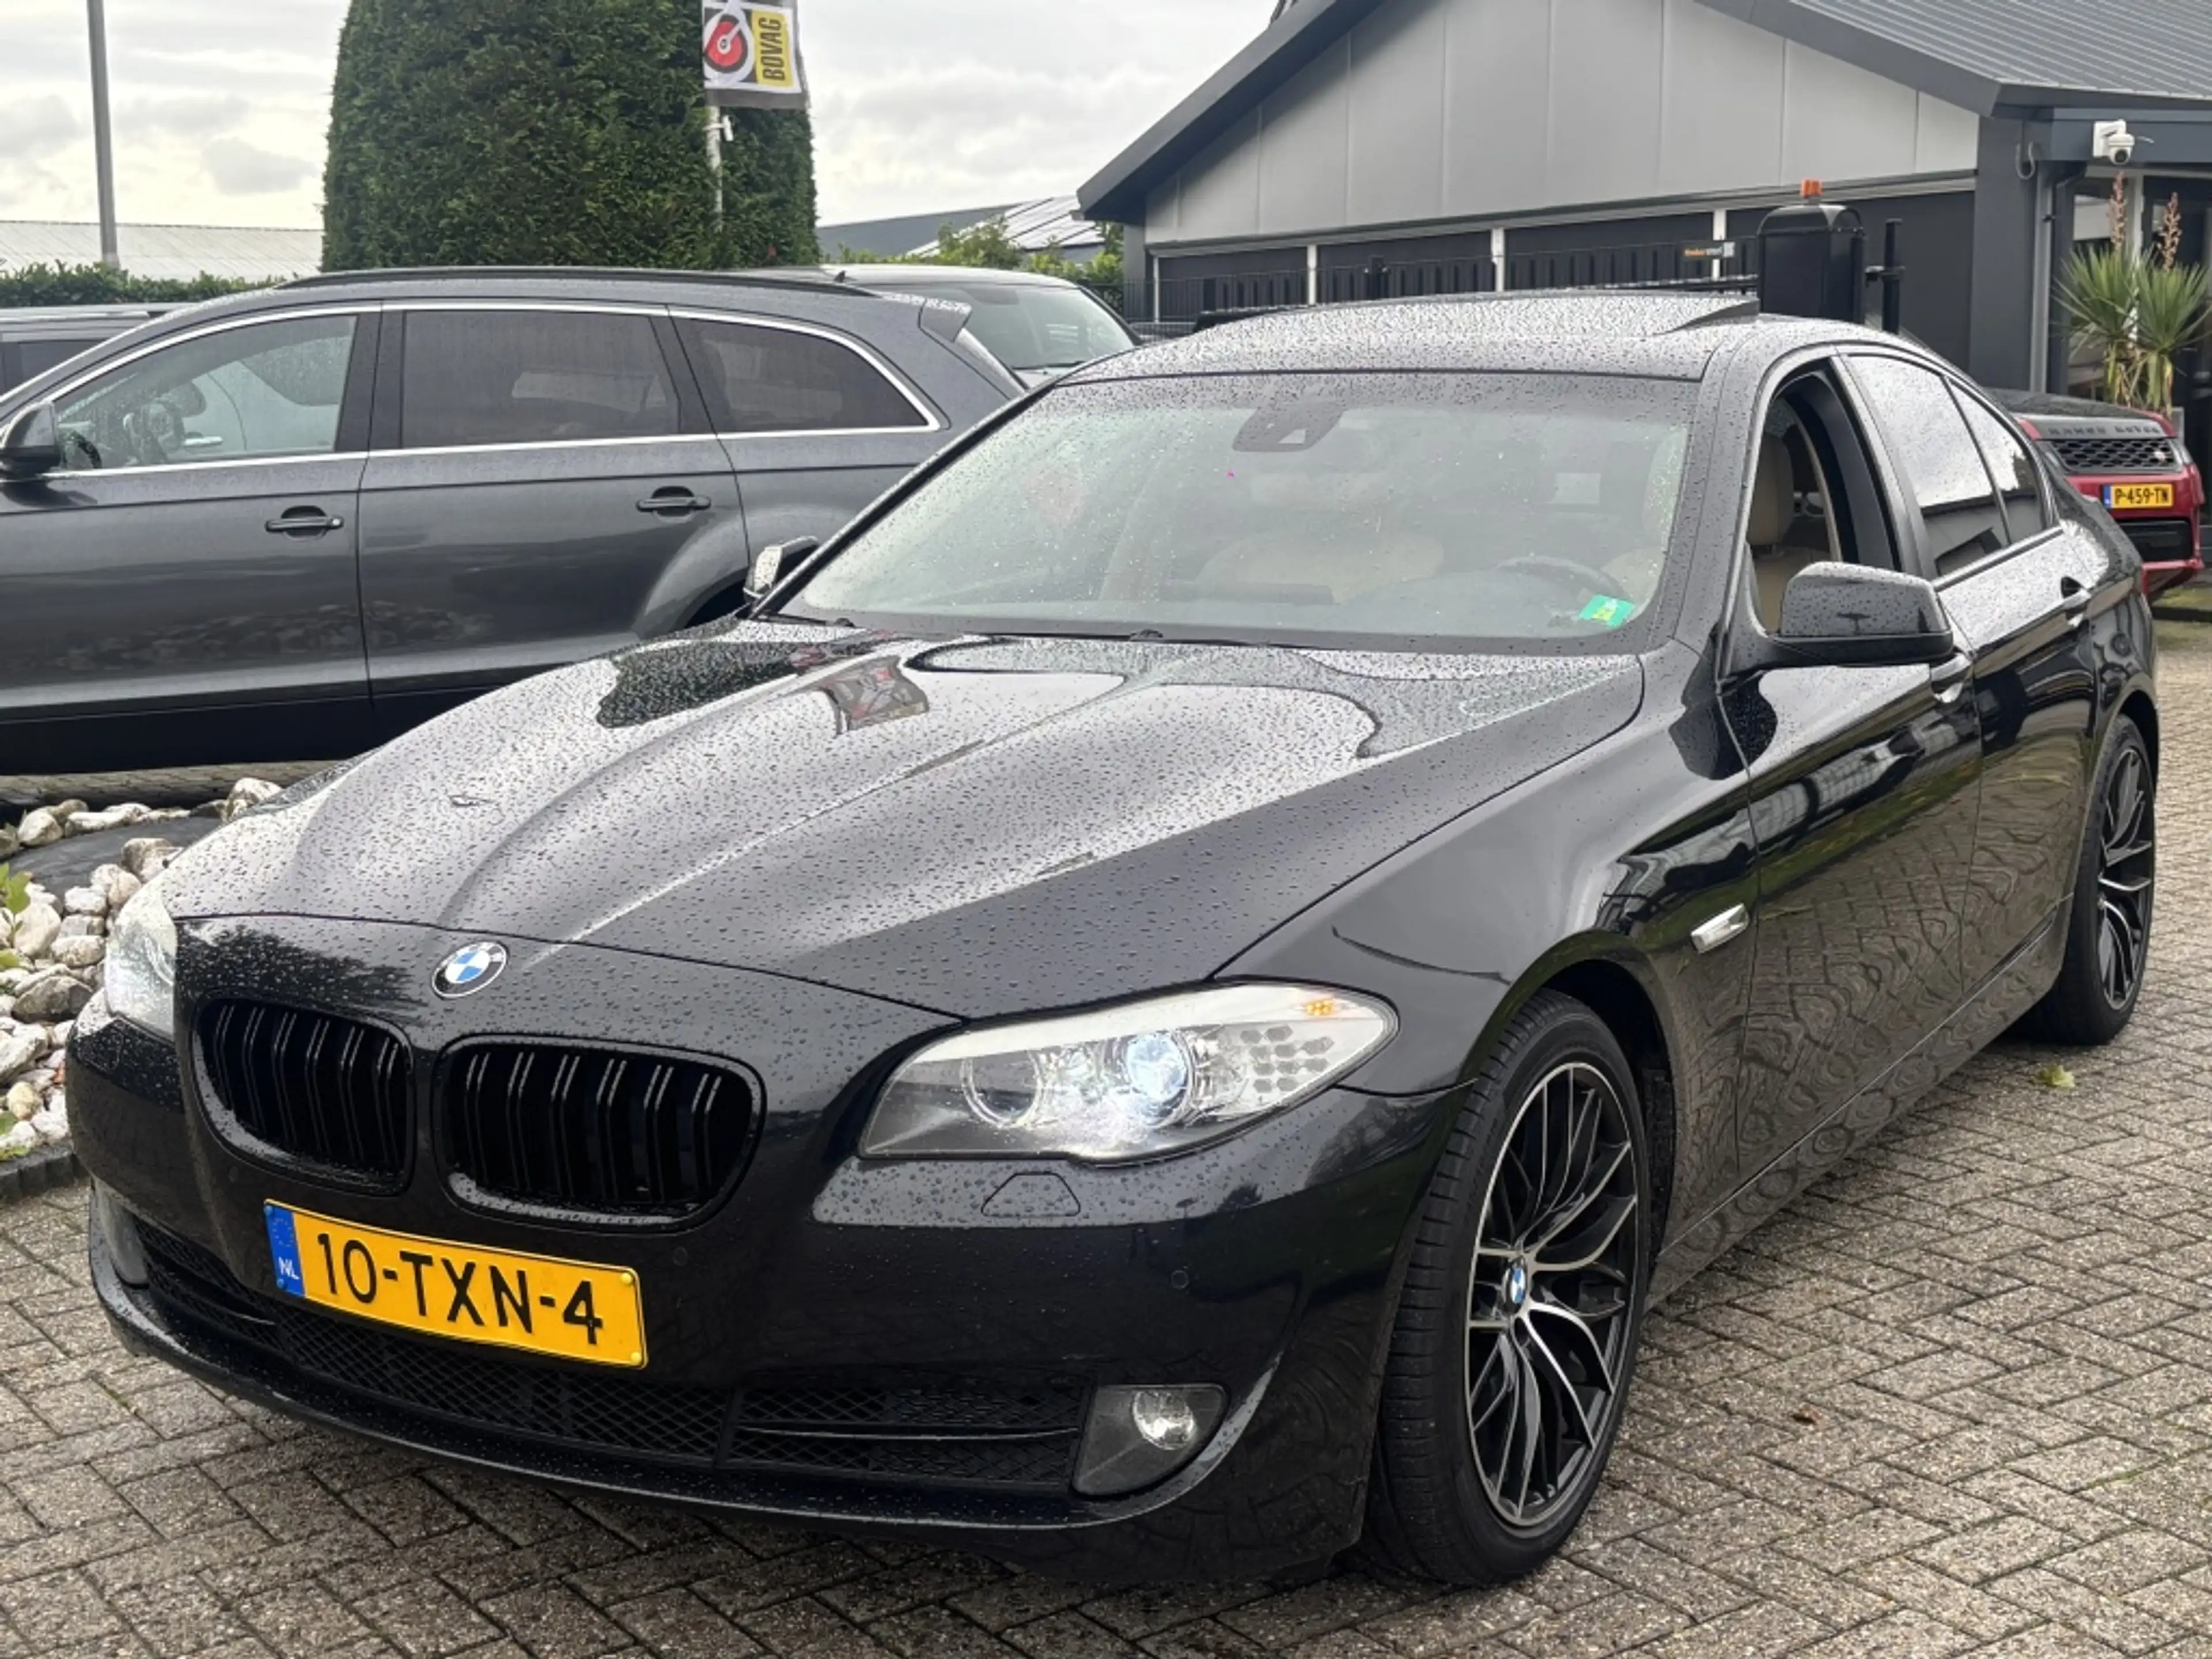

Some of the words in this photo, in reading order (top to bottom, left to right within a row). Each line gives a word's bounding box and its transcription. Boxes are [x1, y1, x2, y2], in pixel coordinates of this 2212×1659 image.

[758, 17, 785, 81] BOVAG
[278, 1256, 299, 1279] NL
[317, 1233, 603, 1345] 10-TXN-4
